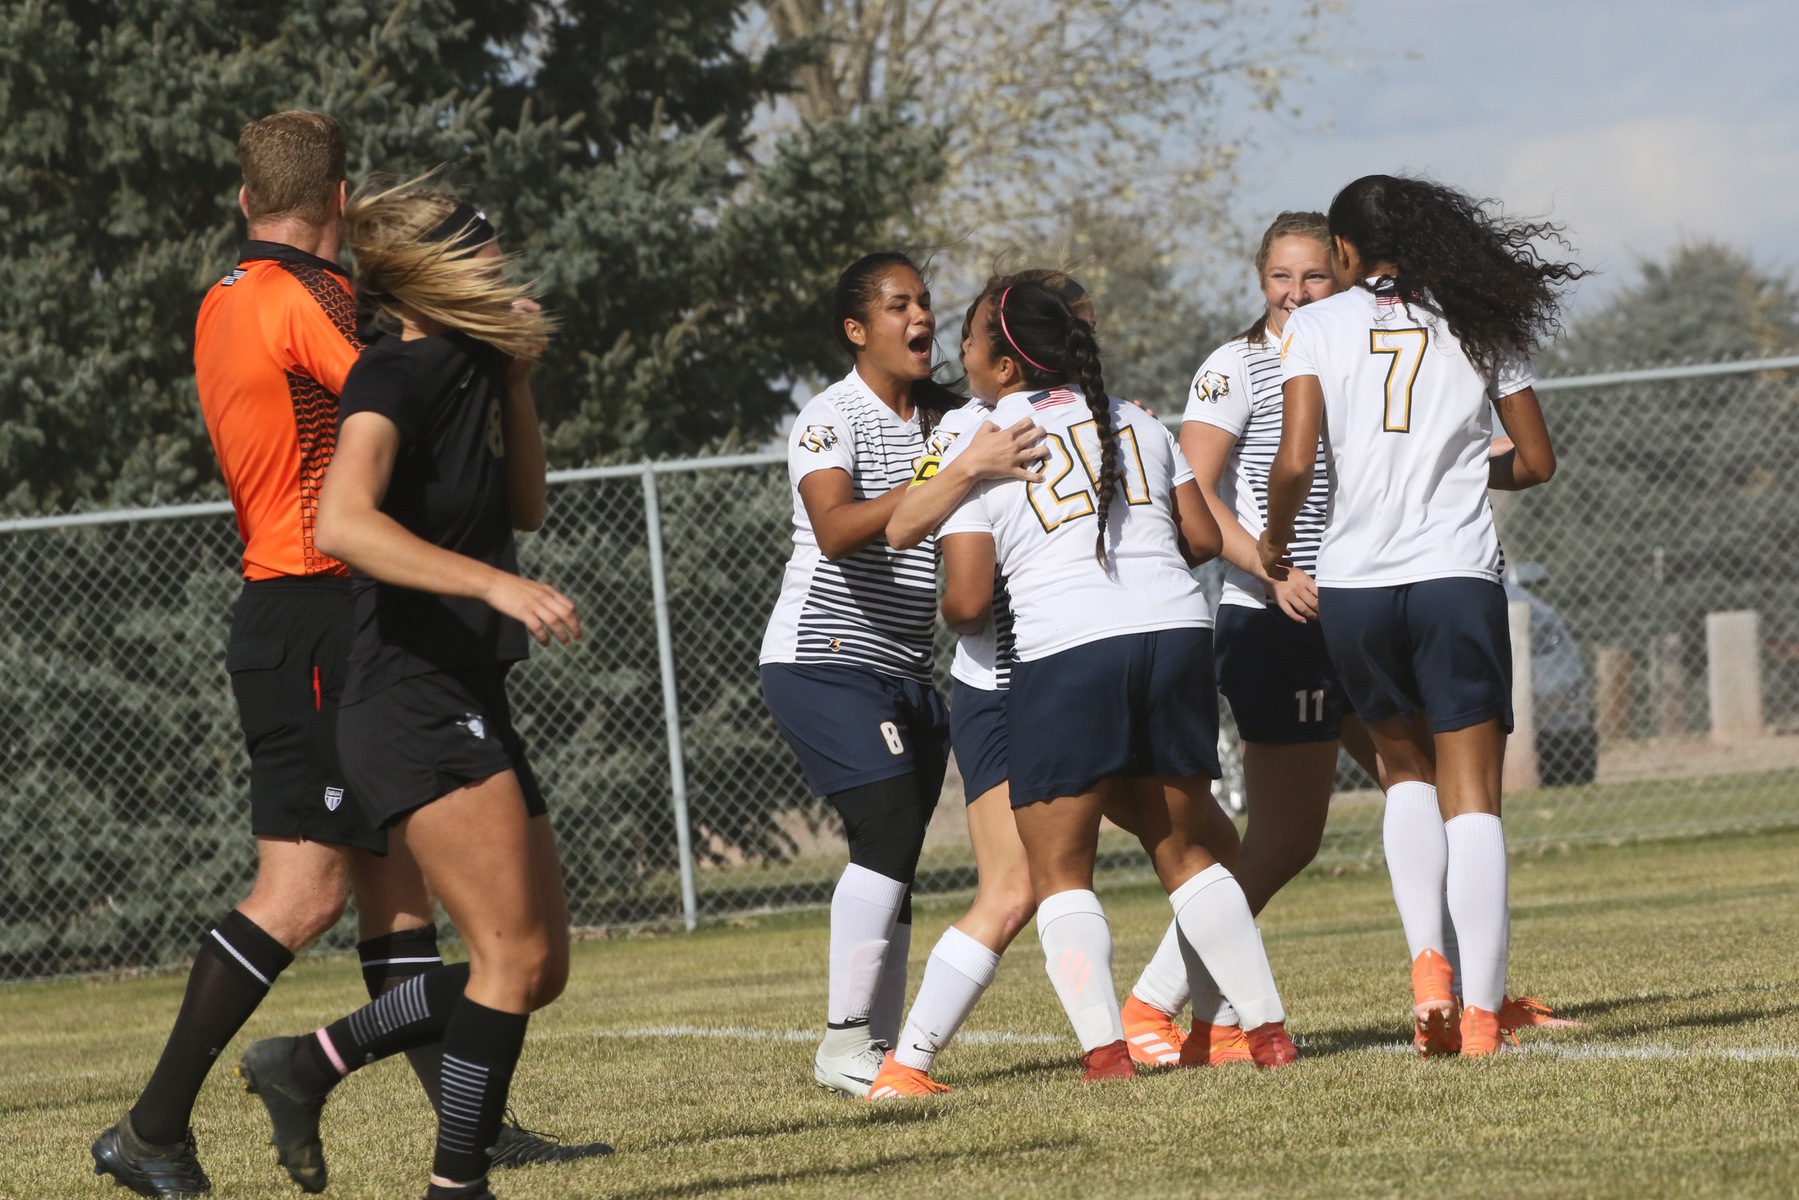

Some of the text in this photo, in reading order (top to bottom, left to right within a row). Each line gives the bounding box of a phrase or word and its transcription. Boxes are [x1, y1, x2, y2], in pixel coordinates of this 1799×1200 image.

[1369, 327, 1429, 433] 7
[1025, 417, 1153, 534] 24
[880, 720, 904, 755] 8
[1294, 688, 1324, 722] 11
